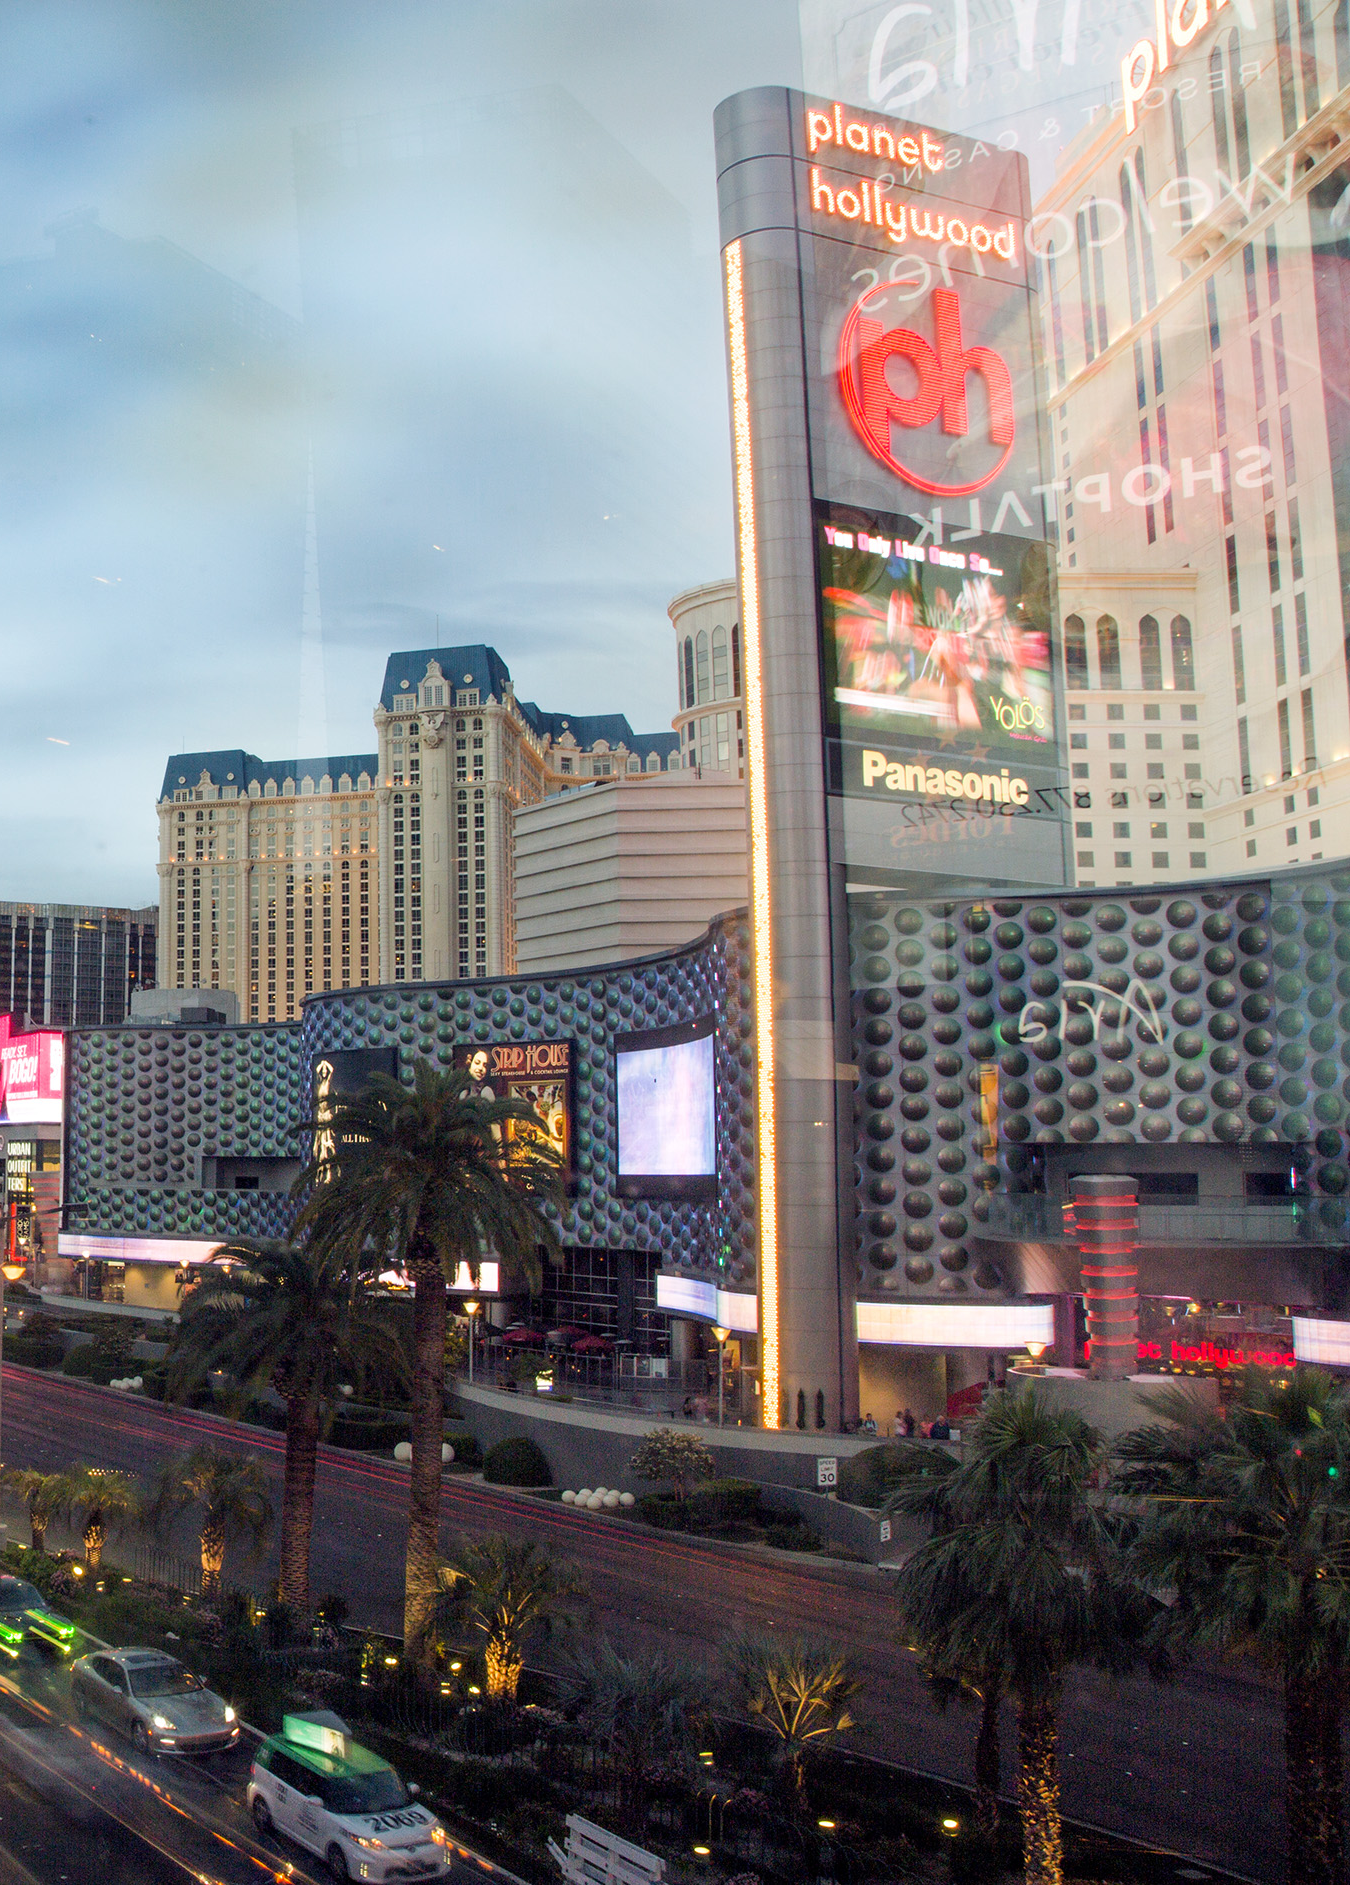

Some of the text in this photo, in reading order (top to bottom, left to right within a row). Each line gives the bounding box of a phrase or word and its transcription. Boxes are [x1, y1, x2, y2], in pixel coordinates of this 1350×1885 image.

[1120, 0, 1230, 136] pla
[807, 101, 947, 172] planet
[810, 164, 1017, 260] hollywood
[858, 287, 1016, 456] ph
[857, 532, 892, 559] Only
[895, 538, 926, 563] Live
[989, 695, 1046, 731] YOLÖS
[862, 749, 1029, 805] Panasonic
[9, 1055, 38, 1085] BOGO!
[490, 1043, 570, 1074] STRIP HOUSE
[7, 1142, 31, 1156] URBAN
[7, 1160, 32, 1174] OUTFIT
[7, 1177, 24, 1192] TERS
[1171, 1340, 1297, 1370] hollywood
[820, 1473, 835, 1483] 30
[365, 1810, 429, 1835] 2069
